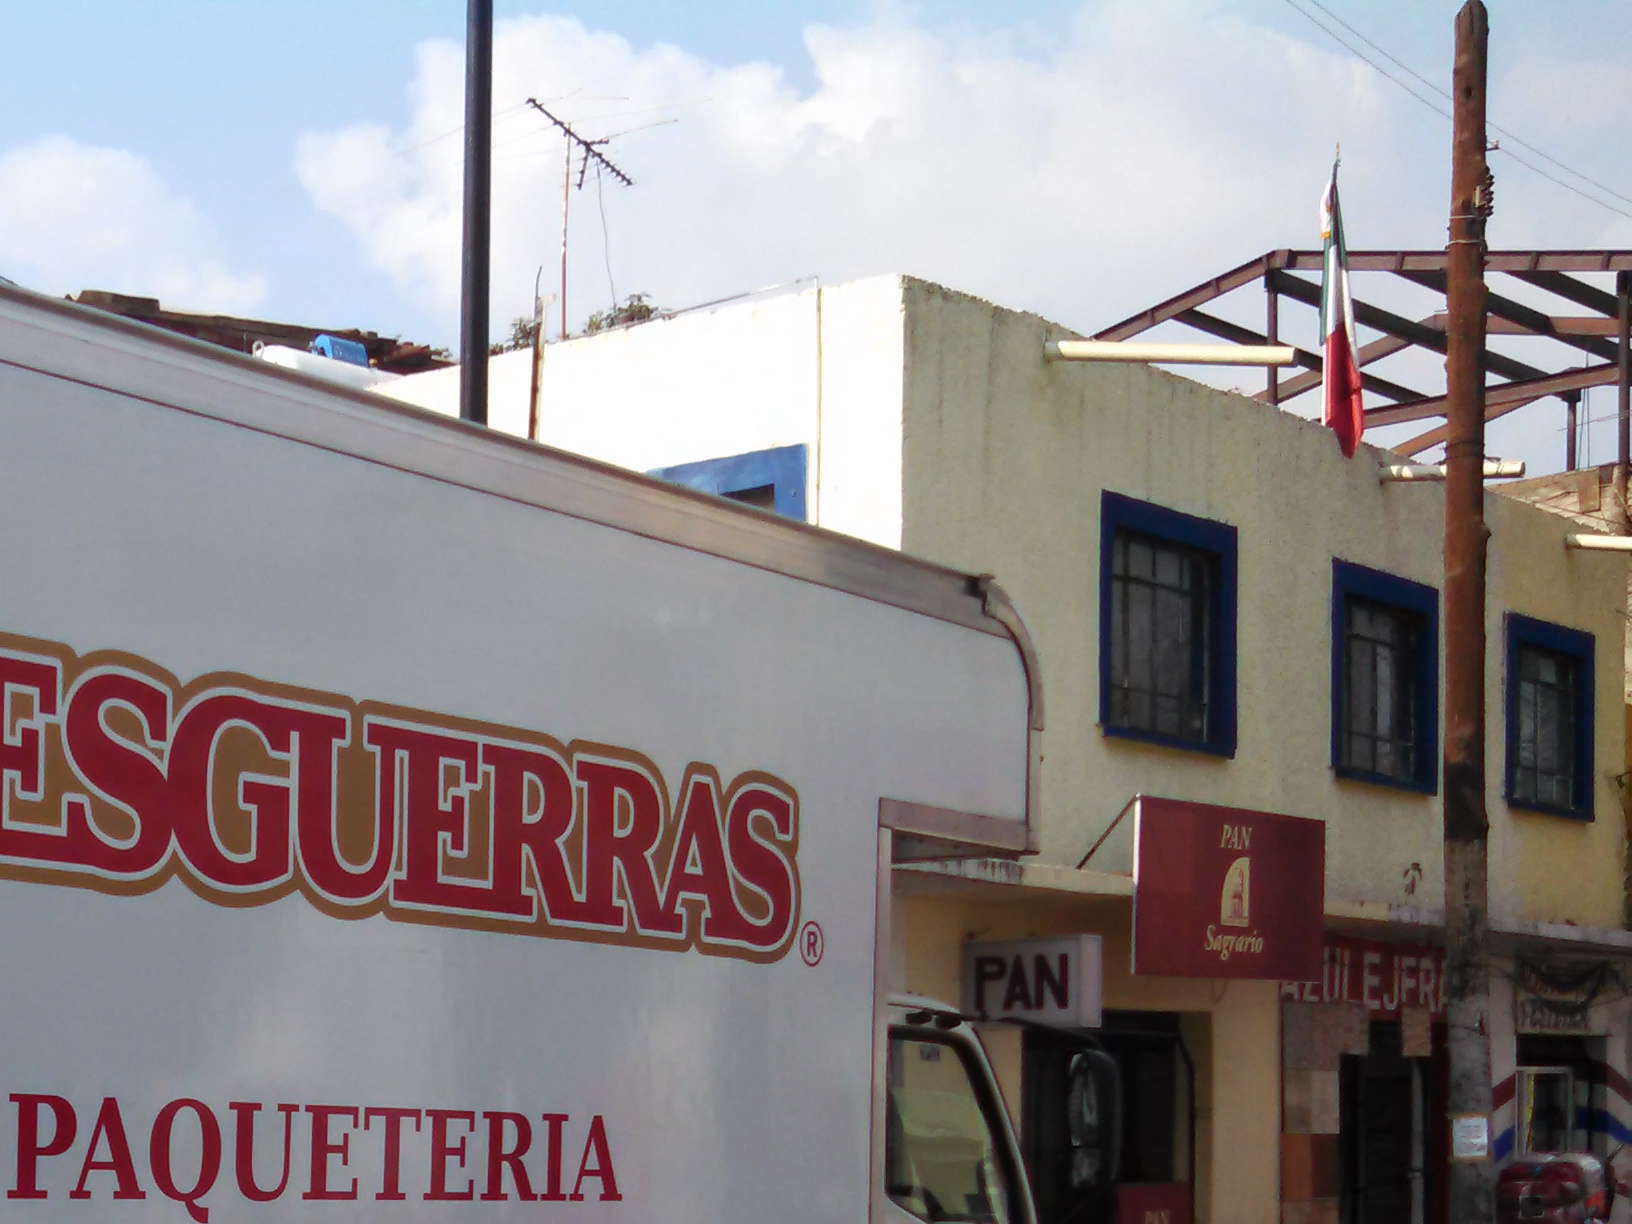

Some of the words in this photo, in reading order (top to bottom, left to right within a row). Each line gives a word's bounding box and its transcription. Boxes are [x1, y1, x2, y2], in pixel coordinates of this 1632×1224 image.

[1219, 824, 1253, 851] PAN
[1204, 924, 1265, 962] Sagrario
[974, 953, 1069, 1011] PAN
[6, 1092, 624, 1224] PAQUETERIA
